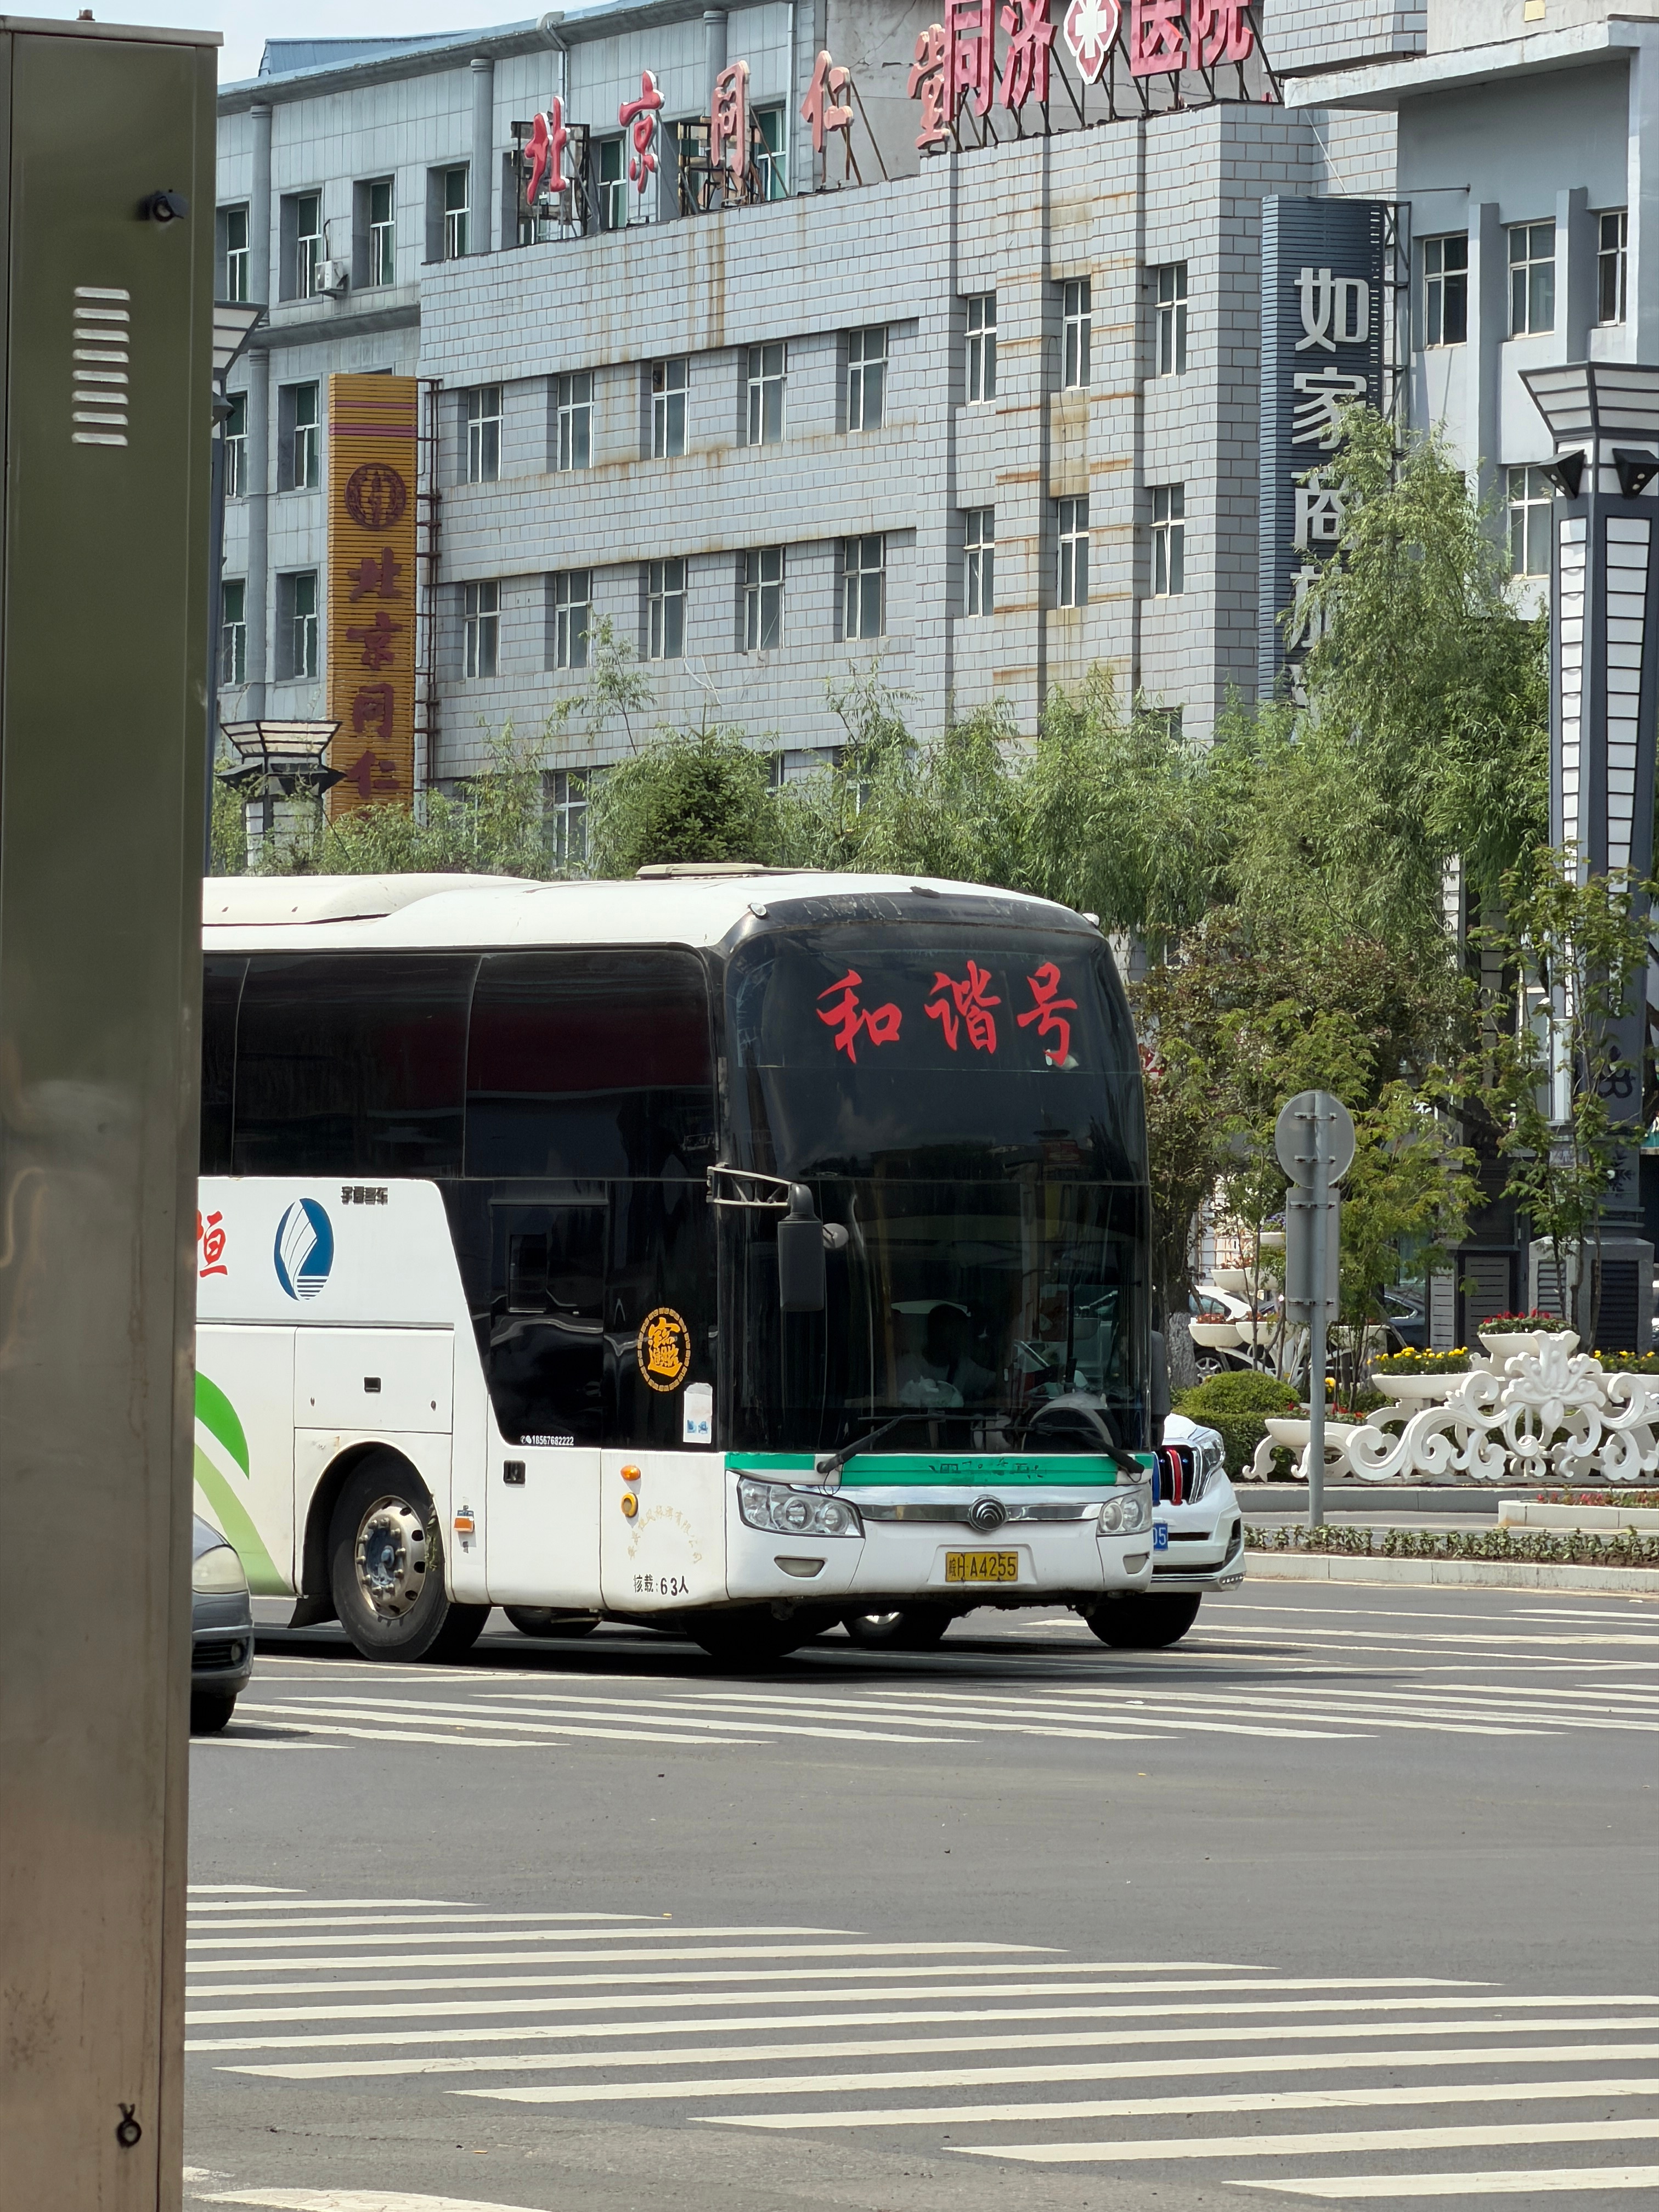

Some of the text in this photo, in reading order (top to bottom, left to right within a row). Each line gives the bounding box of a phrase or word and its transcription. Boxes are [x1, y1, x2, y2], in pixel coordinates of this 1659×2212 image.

[524, 24, 951, 205] 北京同仁堂
[346, 546, 404, 835] 北京同仁
[816, 960, 1078, 1066] 和谐号
